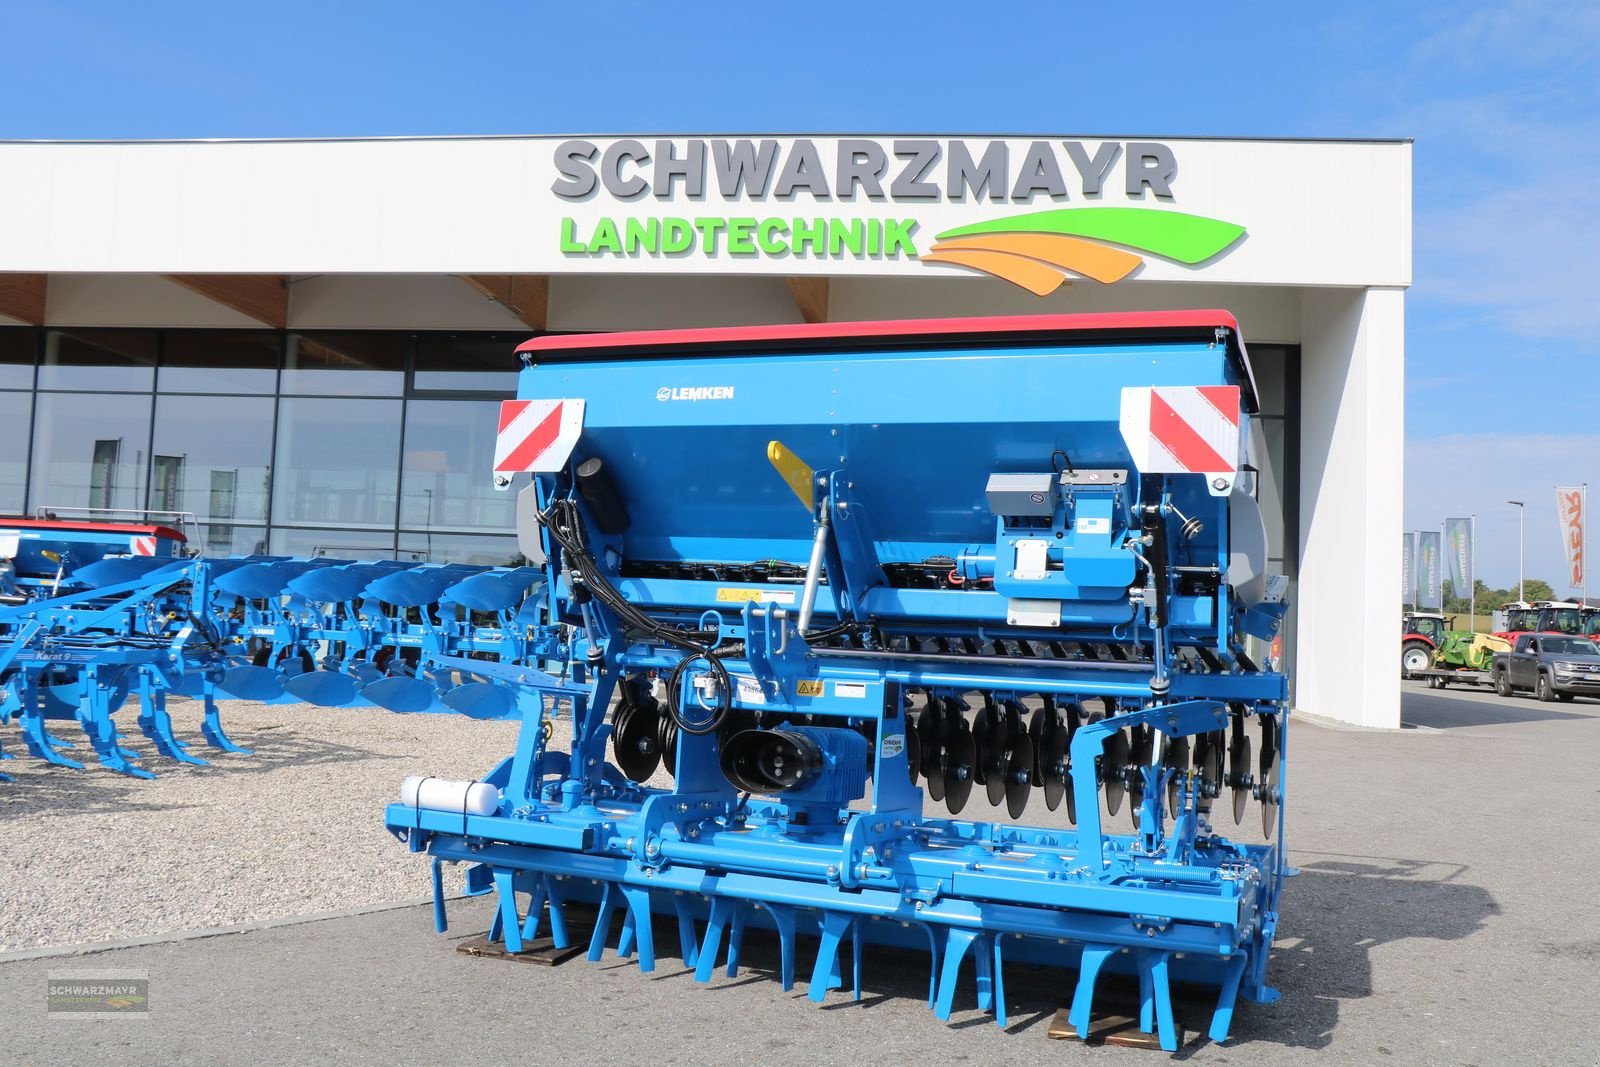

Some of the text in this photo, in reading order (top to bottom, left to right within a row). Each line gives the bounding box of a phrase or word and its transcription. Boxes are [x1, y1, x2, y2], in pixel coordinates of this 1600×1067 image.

[550, 139, 1176, 199] SCHWARZMAYR
[560, 217, 919, 256] LANDTECHNIK
[671, 386, 734, 401] LEMKEN
[35, 652, 63, 660] Karat
